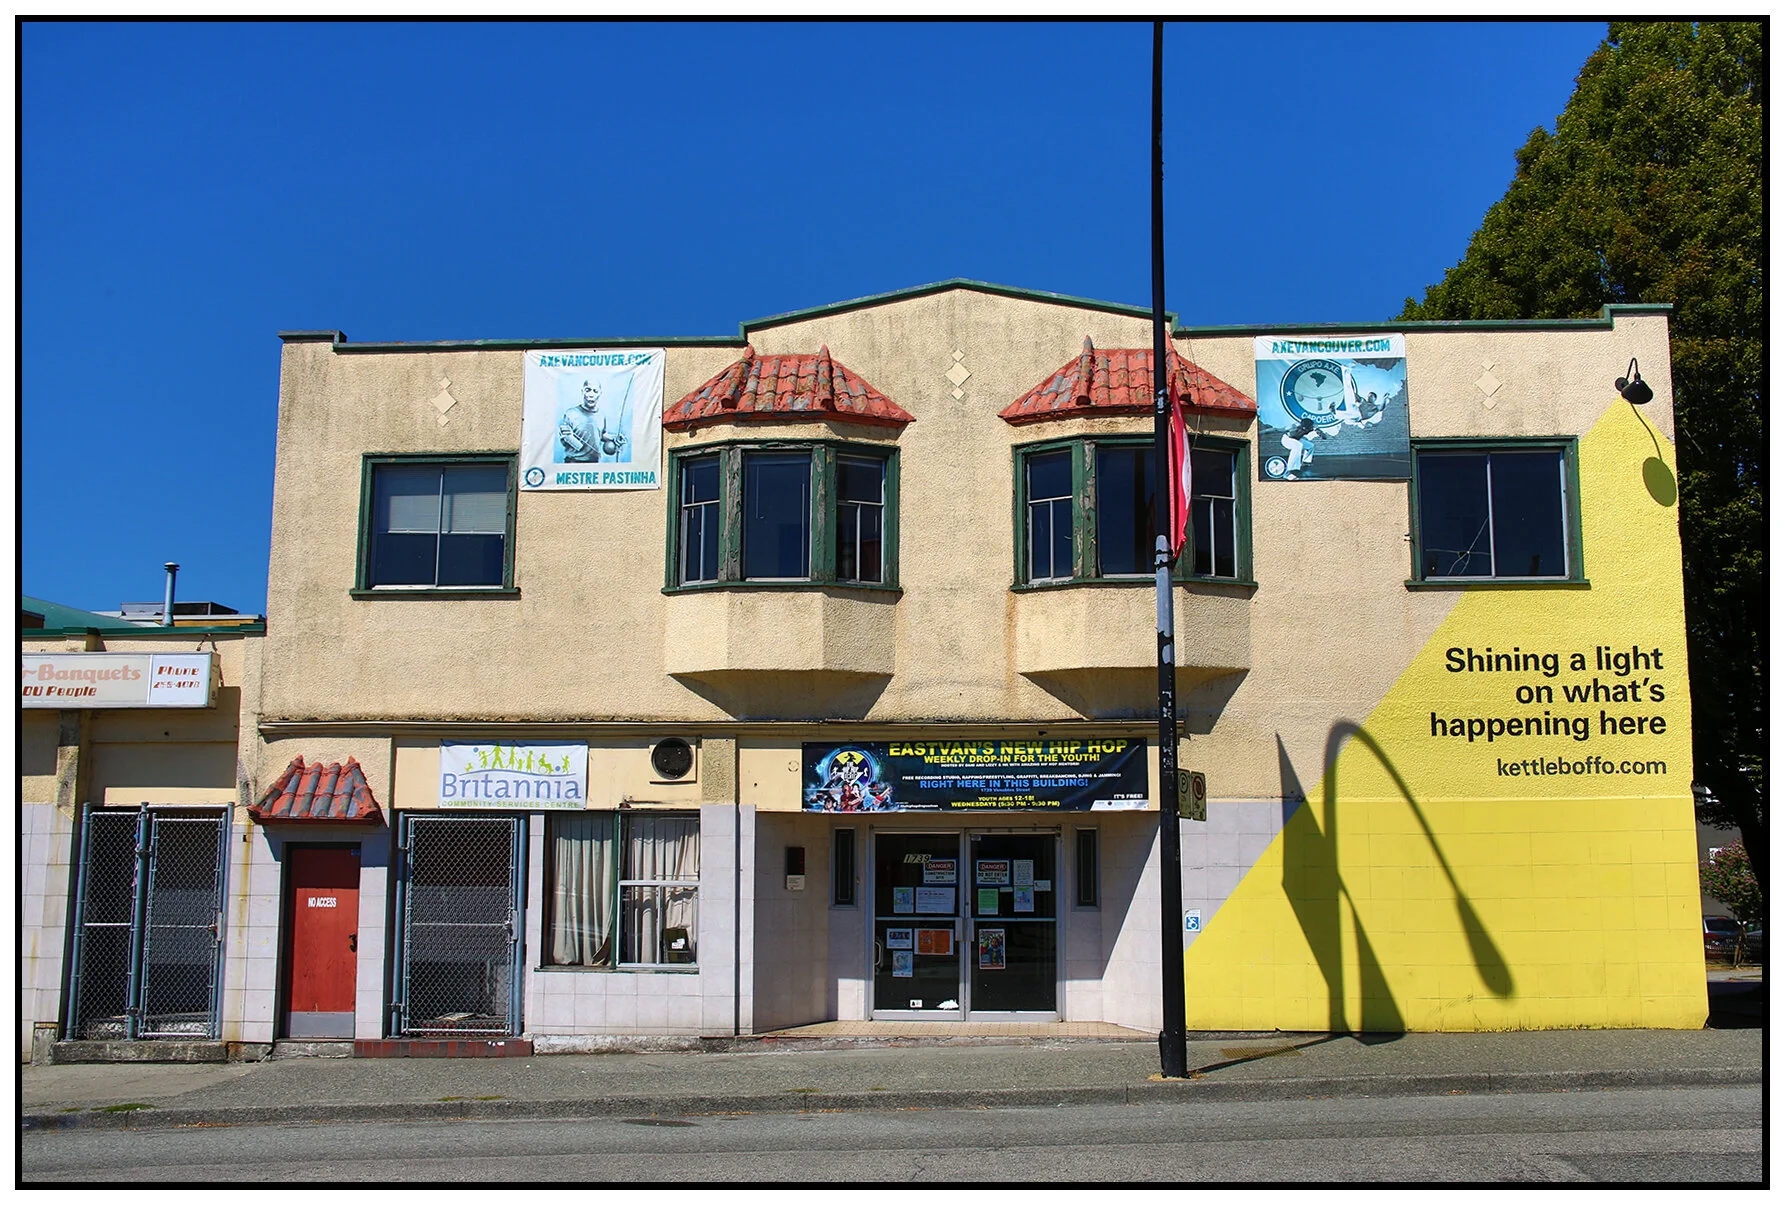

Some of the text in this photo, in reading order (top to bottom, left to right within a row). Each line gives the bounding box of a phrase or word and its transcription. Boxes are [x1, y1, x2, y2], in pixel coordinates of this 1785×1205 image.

[1272, 339, 1390, 354] AXEVANCOUVER.COM
[1298, 360, 1340, 374] GRUPO AXE
[556, 472, 656, 484] MESTRE PASTINHA
[1445, 646, 1664, 677] Shining a light
[37, 664, 142, 684] Banquets
[158, 666, 199, 675] Phone
[46, 686, 97, 697] People
[1516, 677, 1665, 704] on what's
[1430, 710, 1667, 742] happening here
[889, 739, 1128, 756] EASTVAN'S NEW HIP HOP
[969, 755, 1011, 763] DROP-IN
[1038, 754, 1058, 762] THE
[1497, 756, 1667, 776] kettleboffo.com
[442, 773, 582, 799] Britannia
[920, 778, 1088, 788] RIGHT HERE IN THIS BUILDING!
[905, 854, 931, 863] 1739
[308, 897, 337, 907] NO ACCESS
